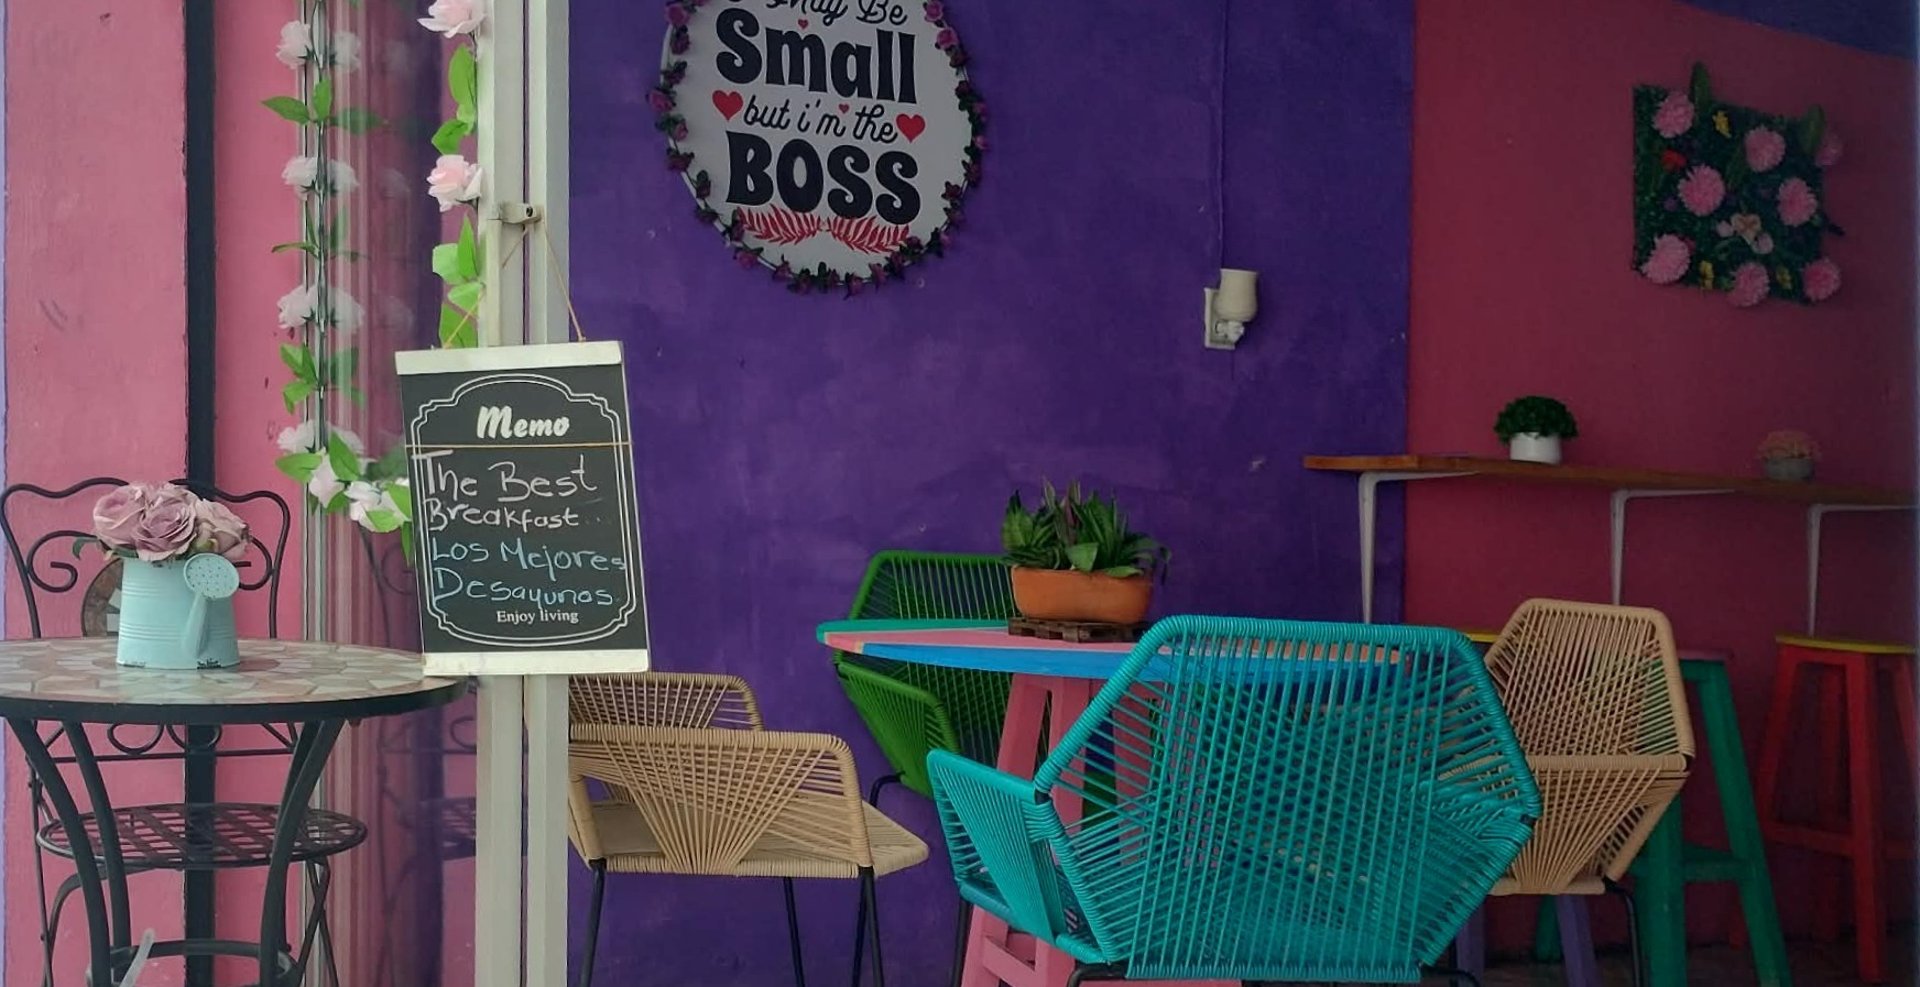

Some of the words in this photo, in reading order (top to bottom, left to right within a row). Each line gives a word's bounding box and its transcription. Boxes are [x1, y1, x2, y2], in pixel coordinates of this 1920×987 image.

[856, 0, 908, 26] Be
[715, 7, 917, 104] Small
[743, 94, 791, 130] but
[797, 98, 847, 138] i'm
[853, 104, 899, 144] the
[725, 130, 921, 225] BOSS
[476, 405, 570, 440] Memo
[411, 449, 478, 501] The
[487, 453, 598, 502] Best
[422, 497, 580, 533] Breakfast
[432, 536, 489, 563] Los
[499, 536, 627, 582] Mejores
[433, 566, 613, 609] Desayunos
[496, 610, 536, 624] Enjoy
[540, 608, 580, 624] living
